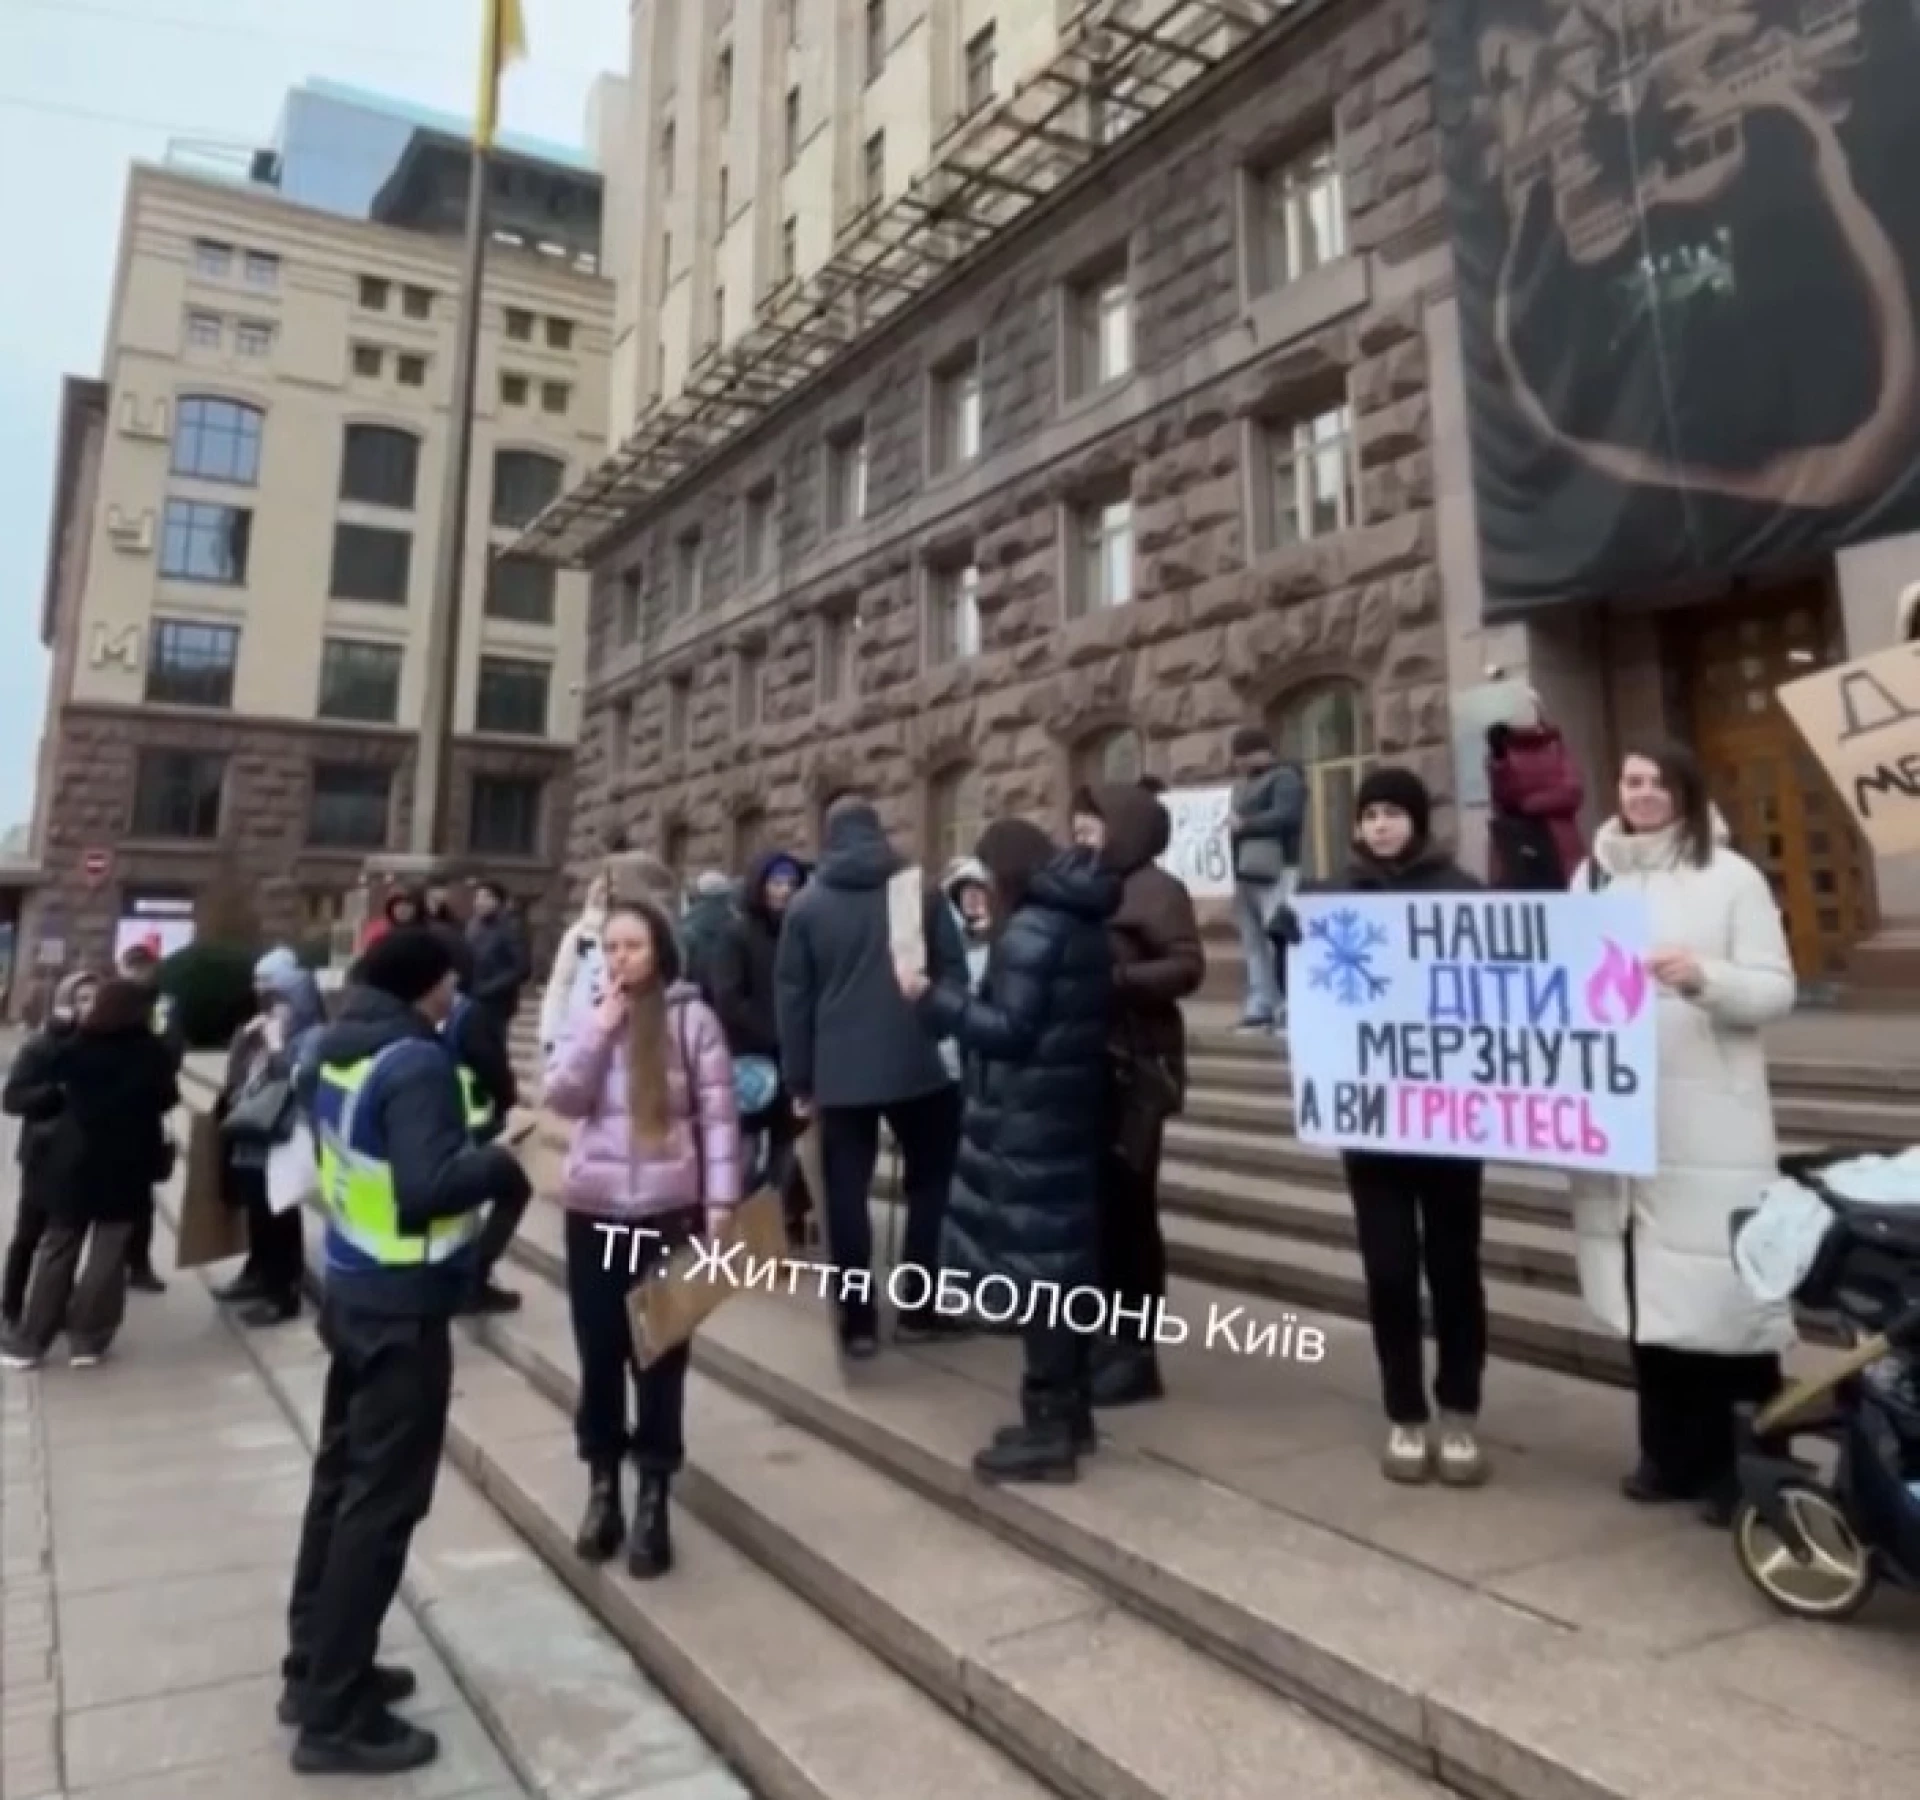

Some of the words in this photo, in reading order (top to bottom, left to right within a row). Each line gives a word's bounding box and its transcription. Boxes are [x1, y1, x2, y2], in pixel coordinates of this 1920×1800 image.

[1837, 650, 1920, 748] Д
[1406, 901, 1549, 962] НАШІ
[1426, 963, 1572, 1026] ДІТИ
[1357, 1020, 1639, 1096] МЕРЗНУТЬ
[1300, 1077, 1322, 1131] А
[1333, 1081, 1387, 1138] ВИ
[1397, 1085, 1609, 1157] ГРІЄТЕСЬ
